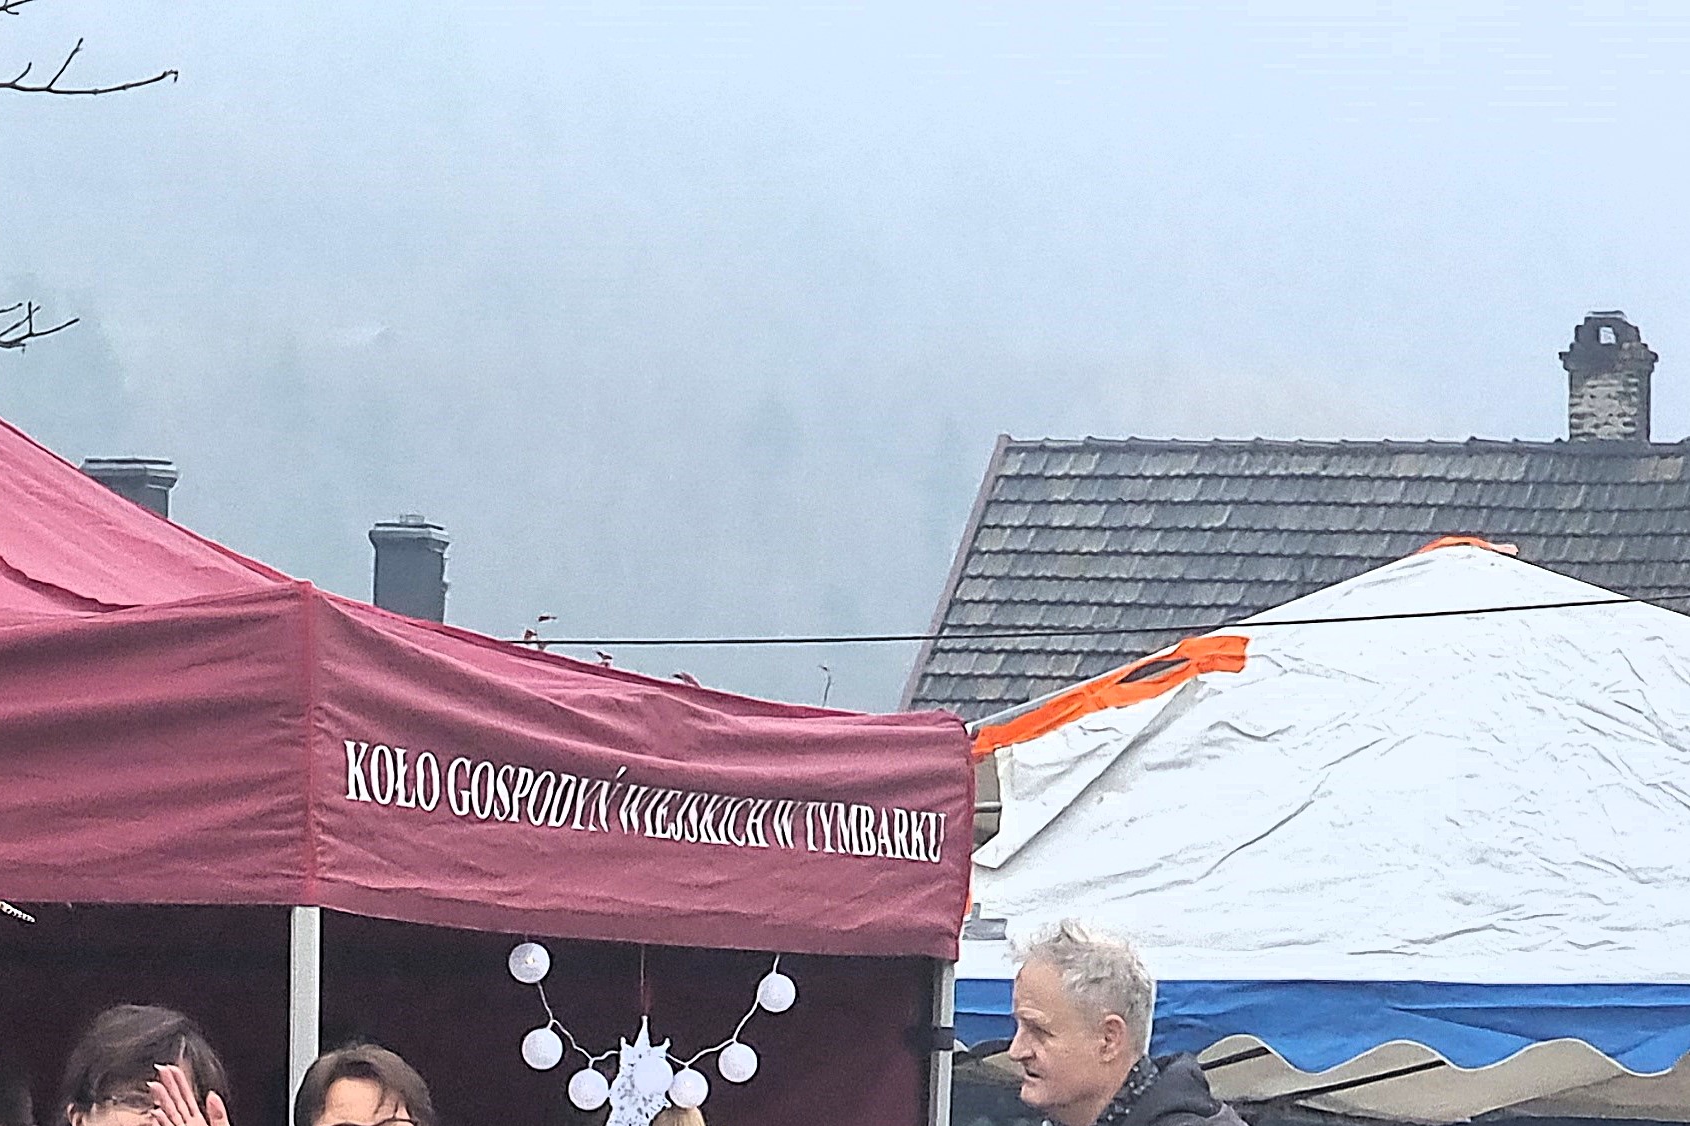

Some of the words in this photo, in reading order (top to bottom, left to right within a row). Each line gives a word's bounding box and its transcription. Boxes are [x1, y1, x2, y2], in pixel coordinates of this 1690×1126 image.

[344, 740, 440, 811] KOŁO
[447, 757, 626, 833] GOSPODYŃ
[618, 783, 770, 848] WIEJSKICH
[772, 798, 803, 849] W
[804, 801, 947, 863] TYMBARKU
